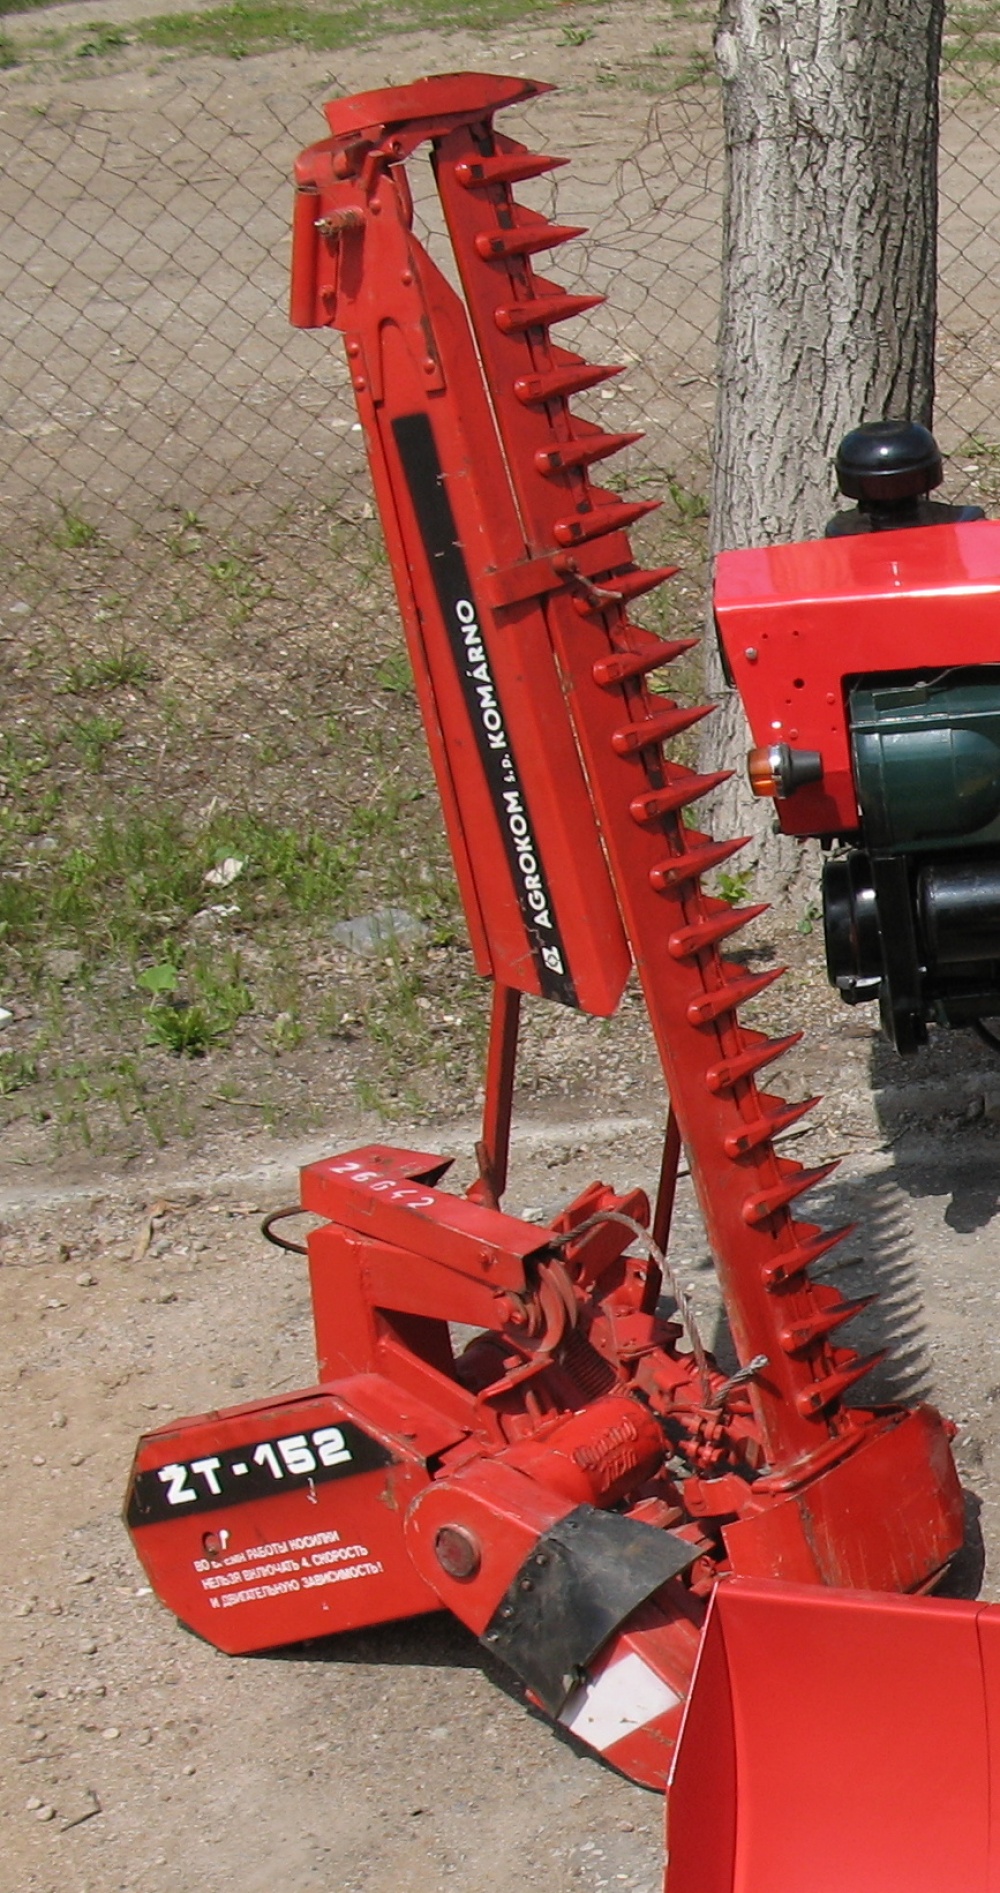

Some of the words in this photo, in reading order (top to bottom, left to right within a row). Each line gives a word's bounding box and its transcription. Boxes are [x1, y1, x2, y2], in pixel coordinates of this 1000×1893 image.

[456, 599, 507, 750] KOMÁRNO
[503, 791, 553, 929] AGROKOM
[193, 1558, 211, 1572] ВО
[245, 1540, 289, 1560] РАБОТЫ
[288, 1530, 341, 1551] КОСИЛКИ
[202, 1571, 242, 1590] НЕЛЬЗЯ
[242, 1558, 300, 1582] ВКЛЮЧАТЬ
[311, 1544, 369, 1567] СКОРОСТЬ
[209, 1597, 220, 1609] И
[301, 1561, 384, 1588] ЗАВИСИМОСТЬ!
